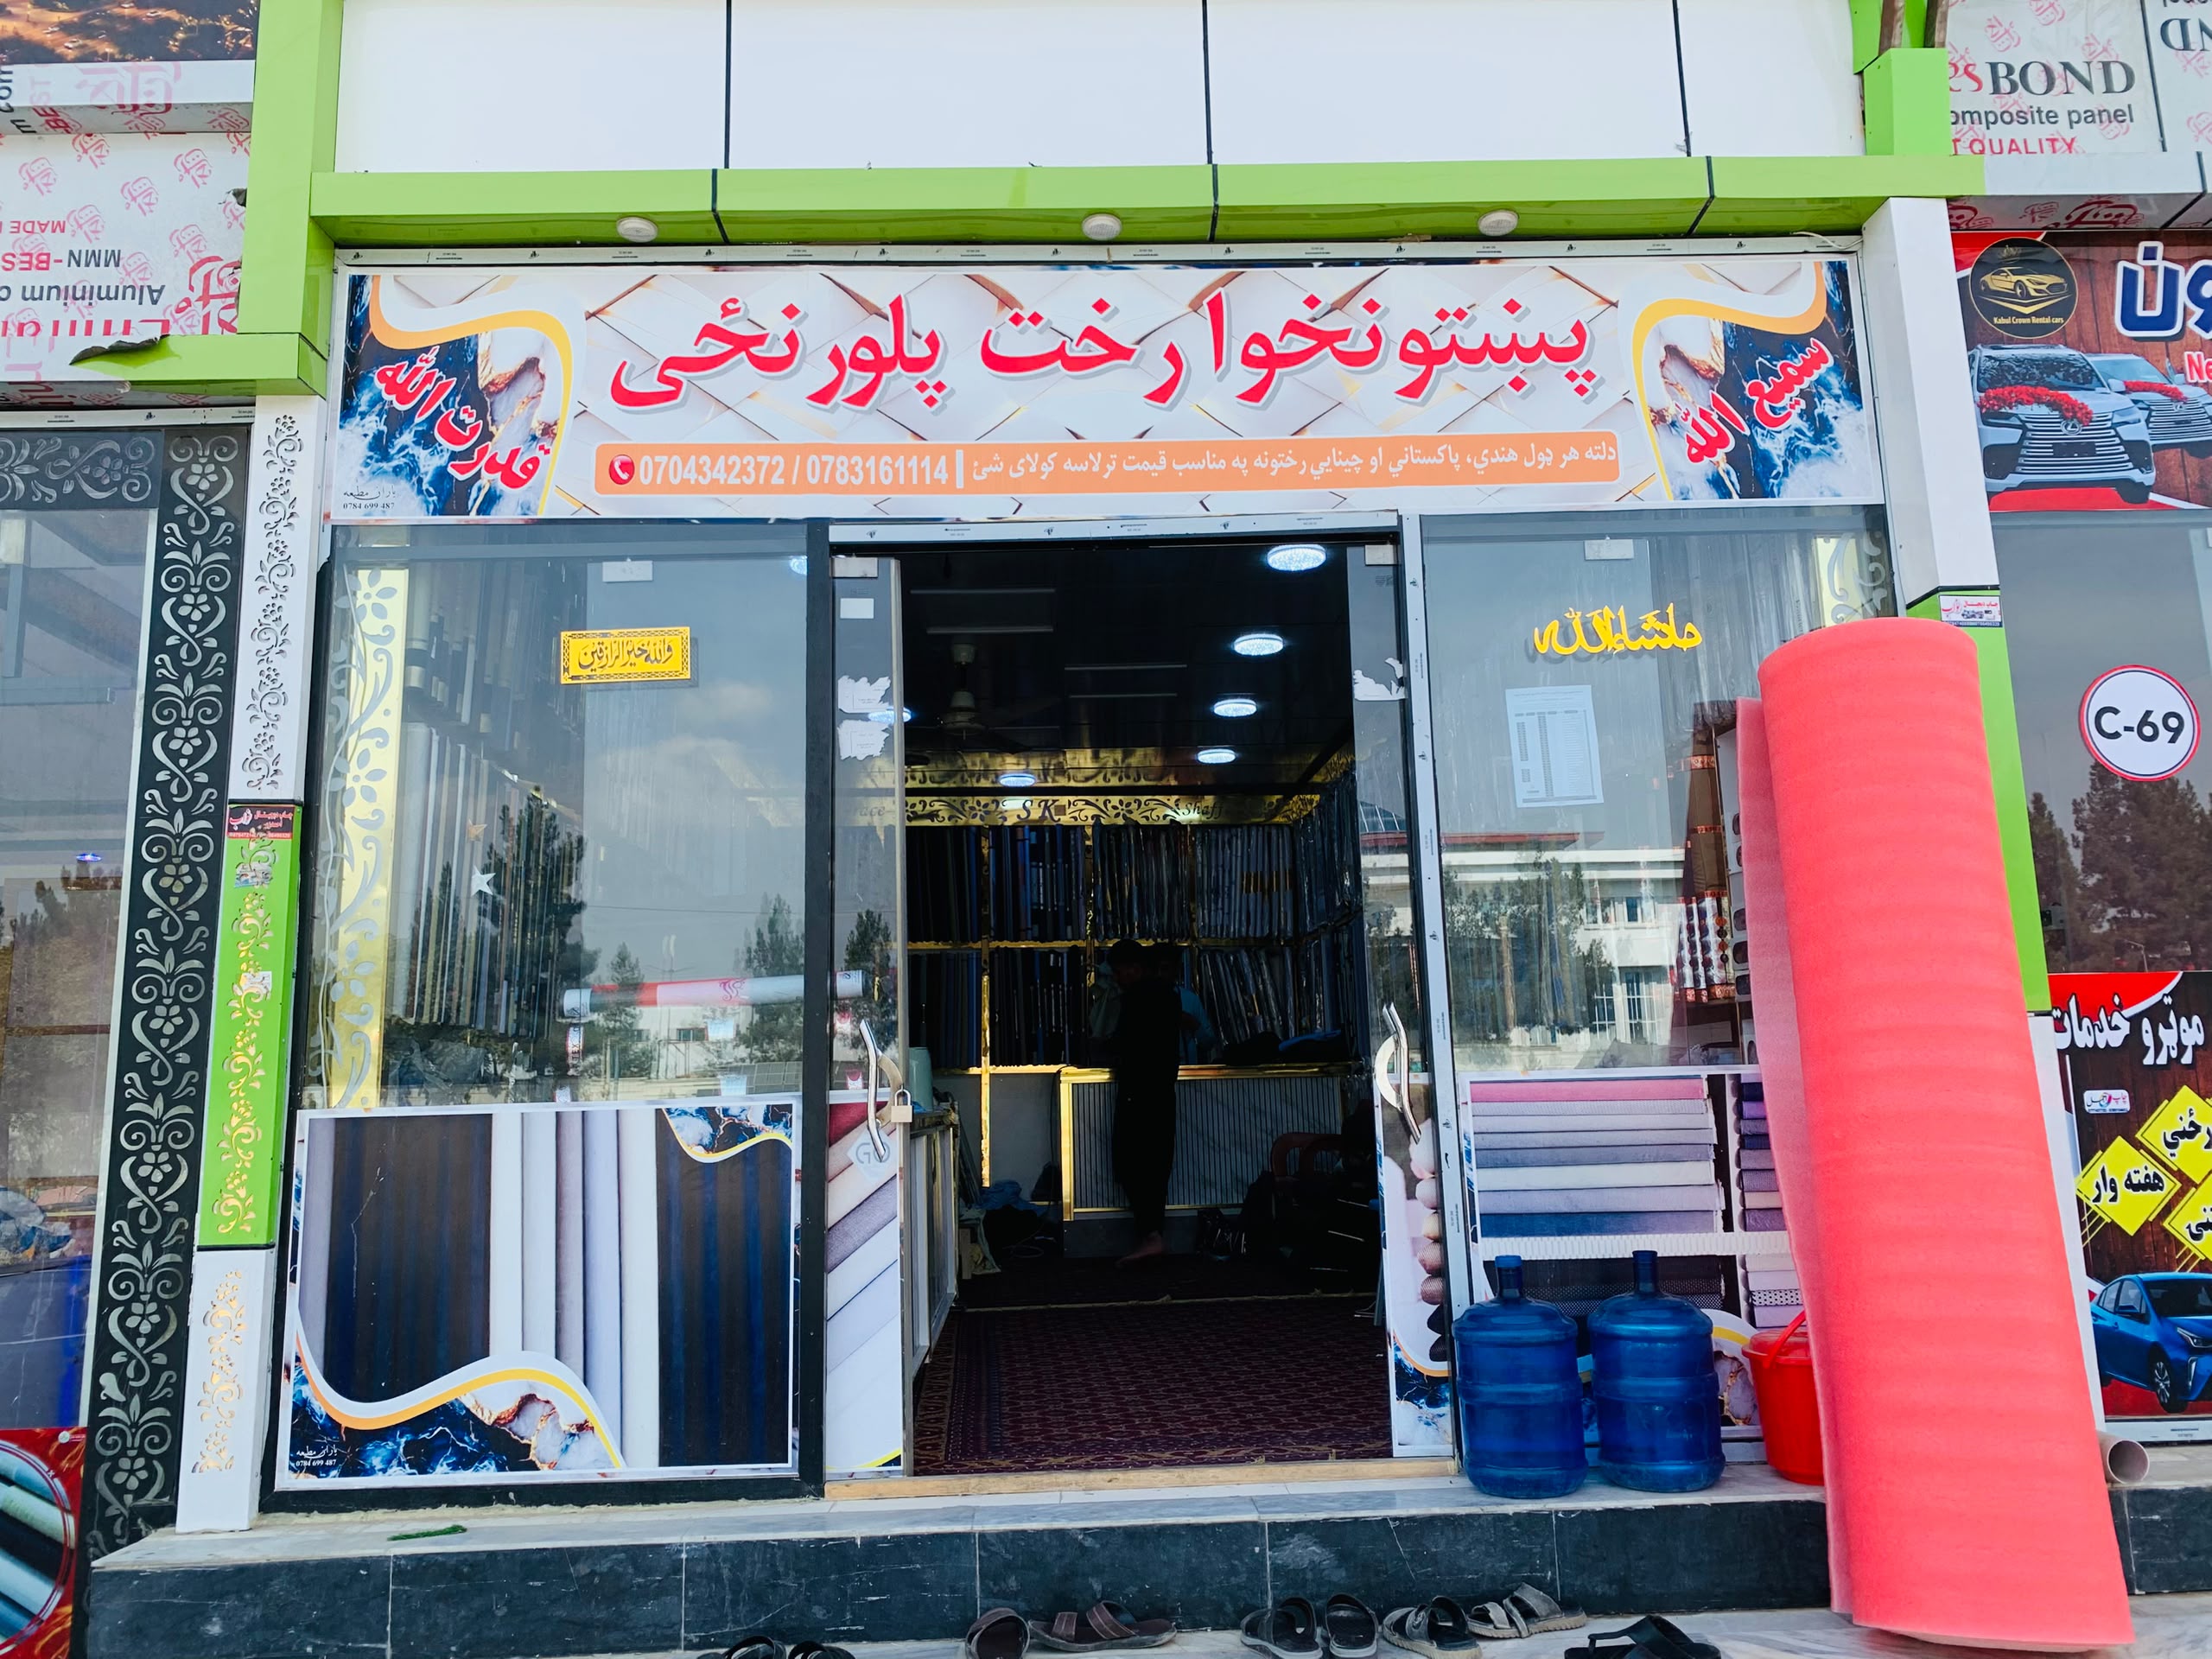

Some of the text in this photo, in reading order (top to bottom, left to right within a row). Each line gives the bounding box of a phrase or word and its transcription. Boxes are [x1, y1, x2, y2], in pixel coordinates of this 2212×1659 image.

[2068, 104, 2134, 130] panel
[1968, 137, 2076, 155] QUALITY
[10, 219, 67, 234] MADE
[21, 283, 166, 306] Aluminium
[2031, 315, 2050, 324] Rental
[981, 297, 1184, 404] رخت
[436, 406, 550, 490] قدرت
[1370, 446, 1382, 474] او
[1559, 445, 1580, 469] هر
[1584, 441, 1617, 462] دلته
[639, 454, 786, 486] 0704342372
[805, 454, 950, 486] 0783161114
[1172, 449, 1226, 477] مناسب
[1231, 455, 1248, 477] په
[2094, 705, 2185, 745] C-69
[2092, 1166, 2165, 1204] هفته وار
